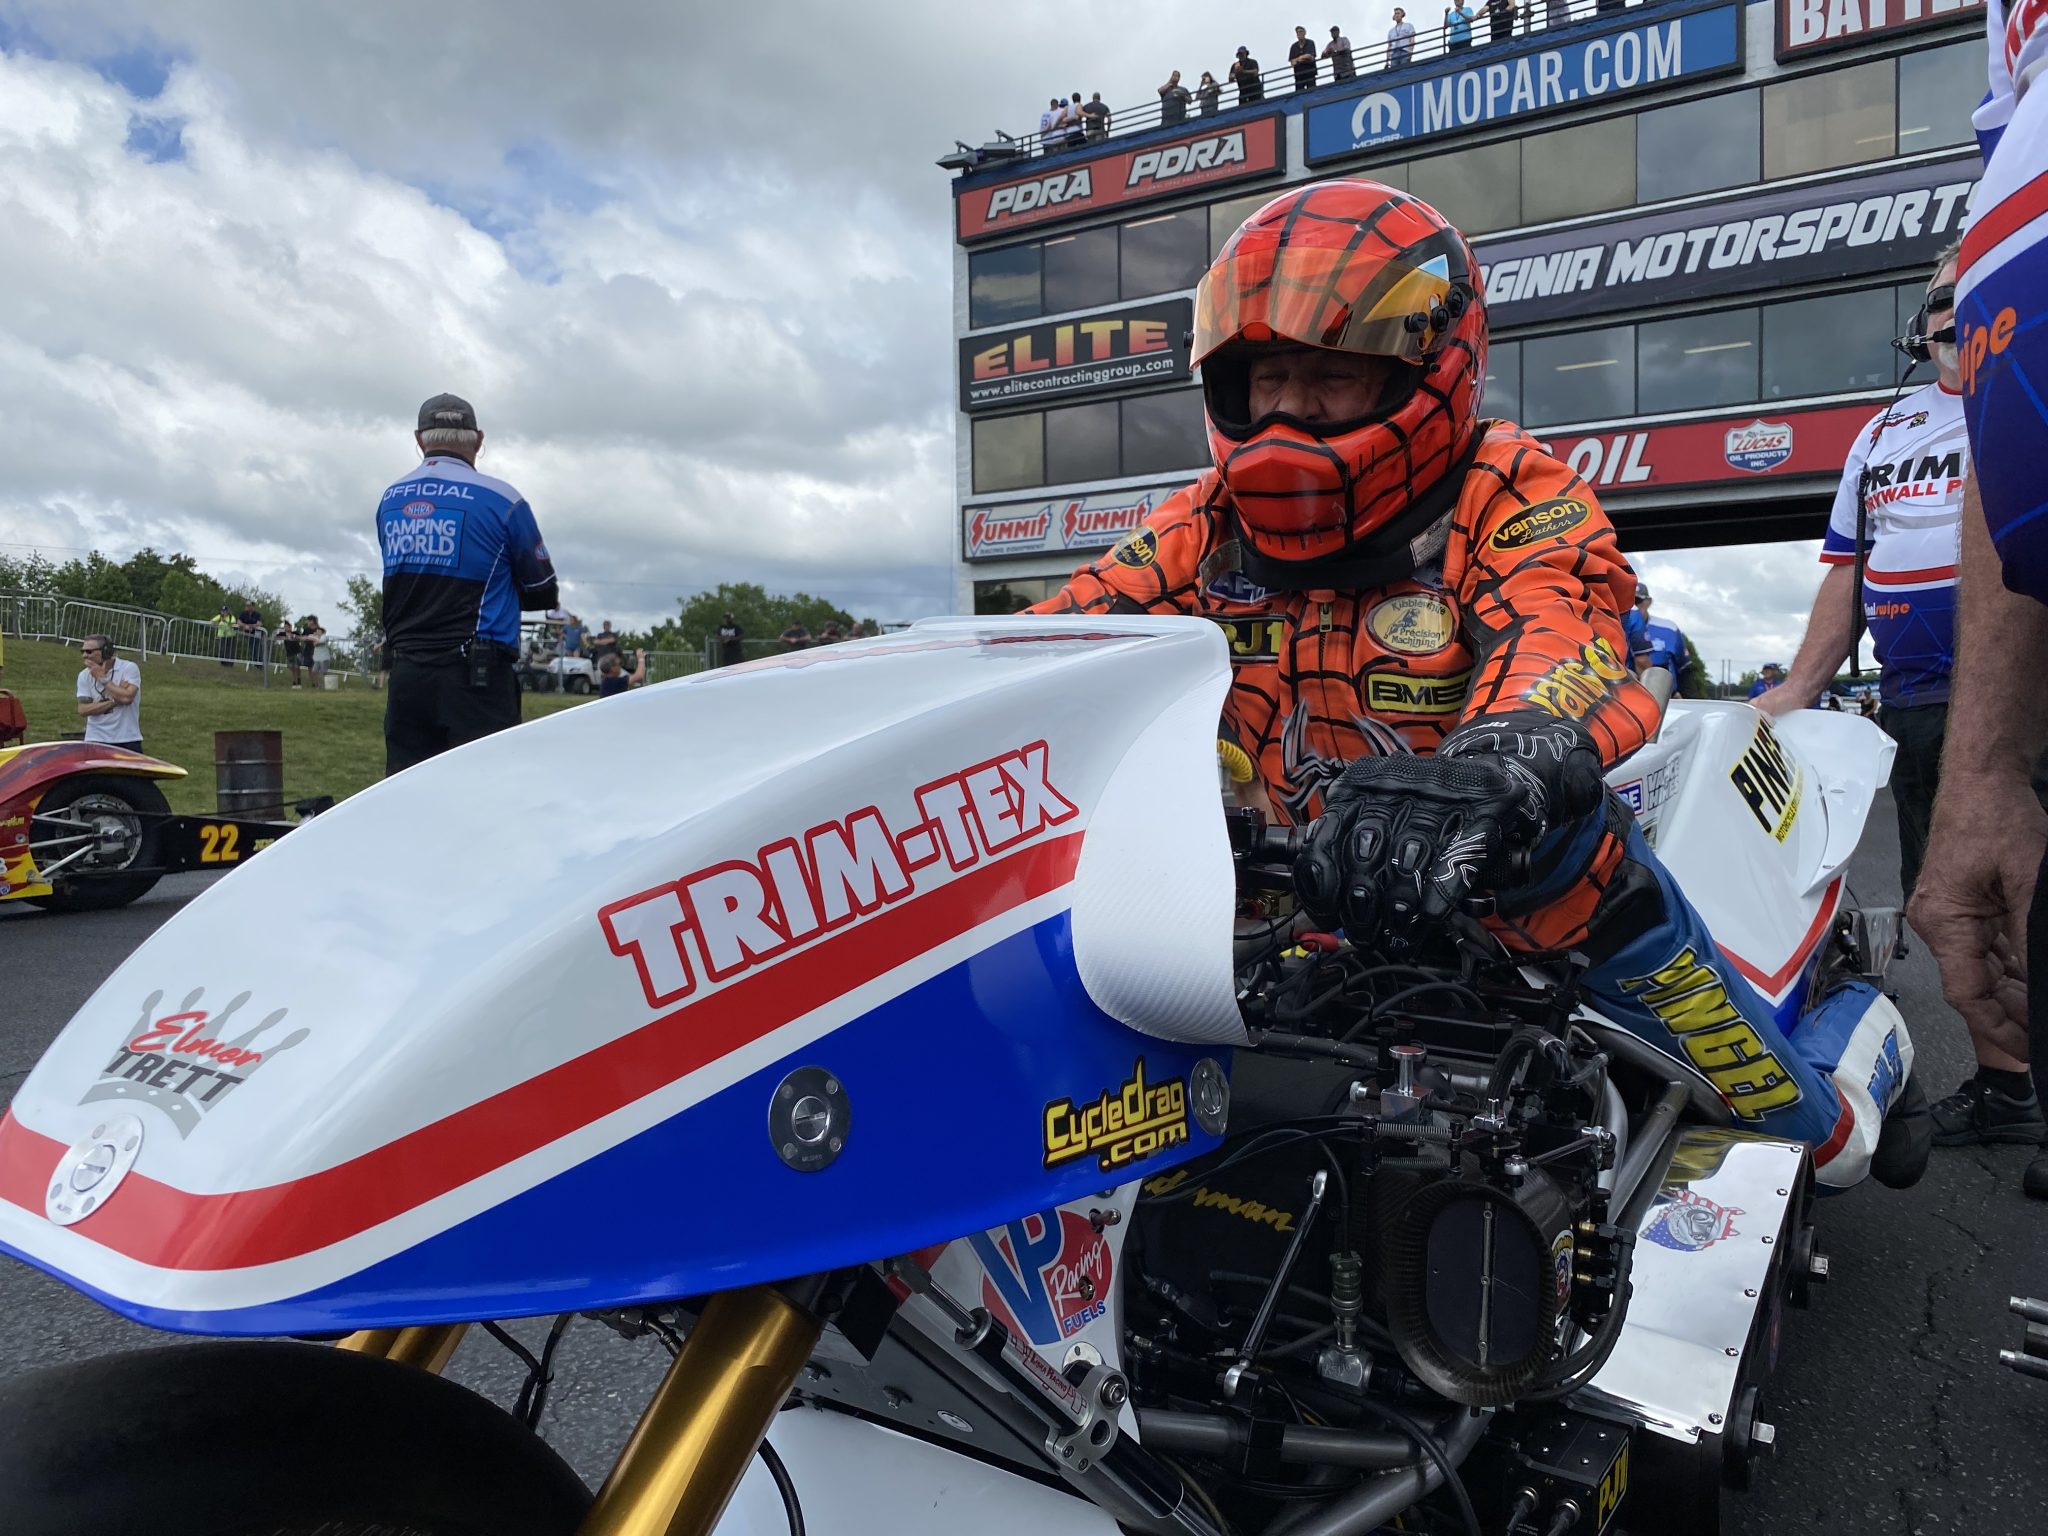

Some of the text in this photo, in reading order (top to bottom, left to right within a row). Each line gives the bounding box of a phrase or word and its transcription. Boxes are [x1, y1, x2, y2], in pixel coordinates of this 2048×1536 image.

[1422, 20, 1682, 134] MOPAR.COM
[1127, 131, 1246, 186] PDRA
[1352, 133, 1401, 150] MOPAR
[987, 169, 1092, 220] PDRA
[1480, 245, 1605, 304] GINIA
[973, 320, 1169, 380] ELITE
[970, 357, 1174, 399] www.elitecontractinggroup.com
[1567, 432, 1652, 485] OIL
[1729, 450, 1788, 462] OIL PRODUCTS
[1733, 435, 1786, 452] LUCAS
[1750, 459, 1768, 468] INC.
[383, 482, 475, 501] OFFICIAL
[1864, 452, 1961, 492] RIM
[408, 504, 432, 514] NHRA
[1865, 482, 1938, 514] RYWALL
[385, 518, 457, 538] CAMPING
[1496, 500, 1586, 542] vanson
[1519, 518, 1573, 544] Leathers
[385, 535, 455, 557] WORLD
[1400, 627, 1441, 641] Precision
[200, 824, 240, 863] 22
[599, 740, 1079, 1009] TRIM-TEX
[129, 1010, 263, 1067] Elmer
[1617, 945, 1803, 1122] PINGEL
[105, 1046, 246, 1103] TRETT
[968, 1206, 1063, 1346] VP
[1050, 1237, 1107, 1318] Racing
[1063, 1300, 1107, 1334] FUELS
